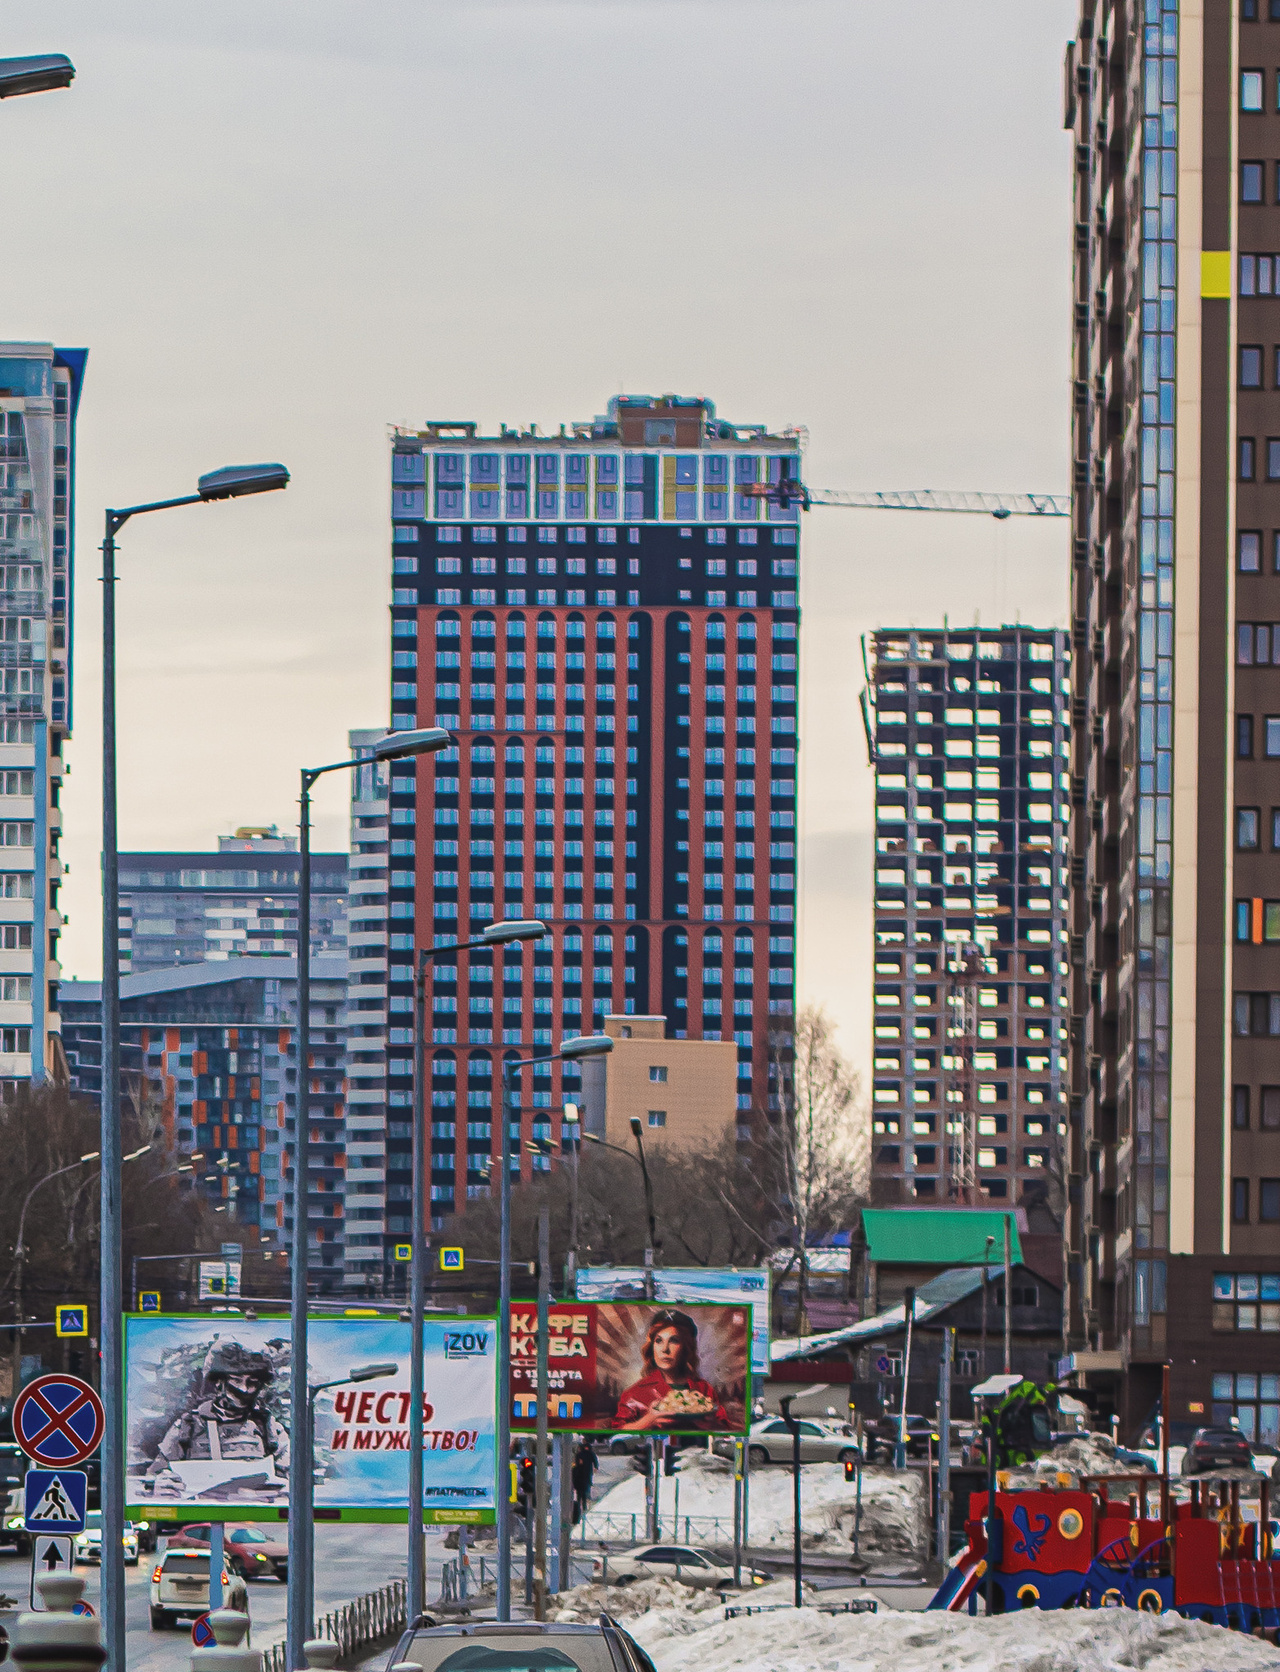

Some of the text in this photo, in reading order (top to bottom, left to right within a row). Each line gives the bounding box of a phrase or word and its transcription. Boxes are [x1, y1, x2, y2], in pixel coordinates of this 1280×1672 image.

[449, 1333, 488, 1351] ZOV
[513, 1369, 521, 1379] С
[331, 1430, 349, 1450] И
